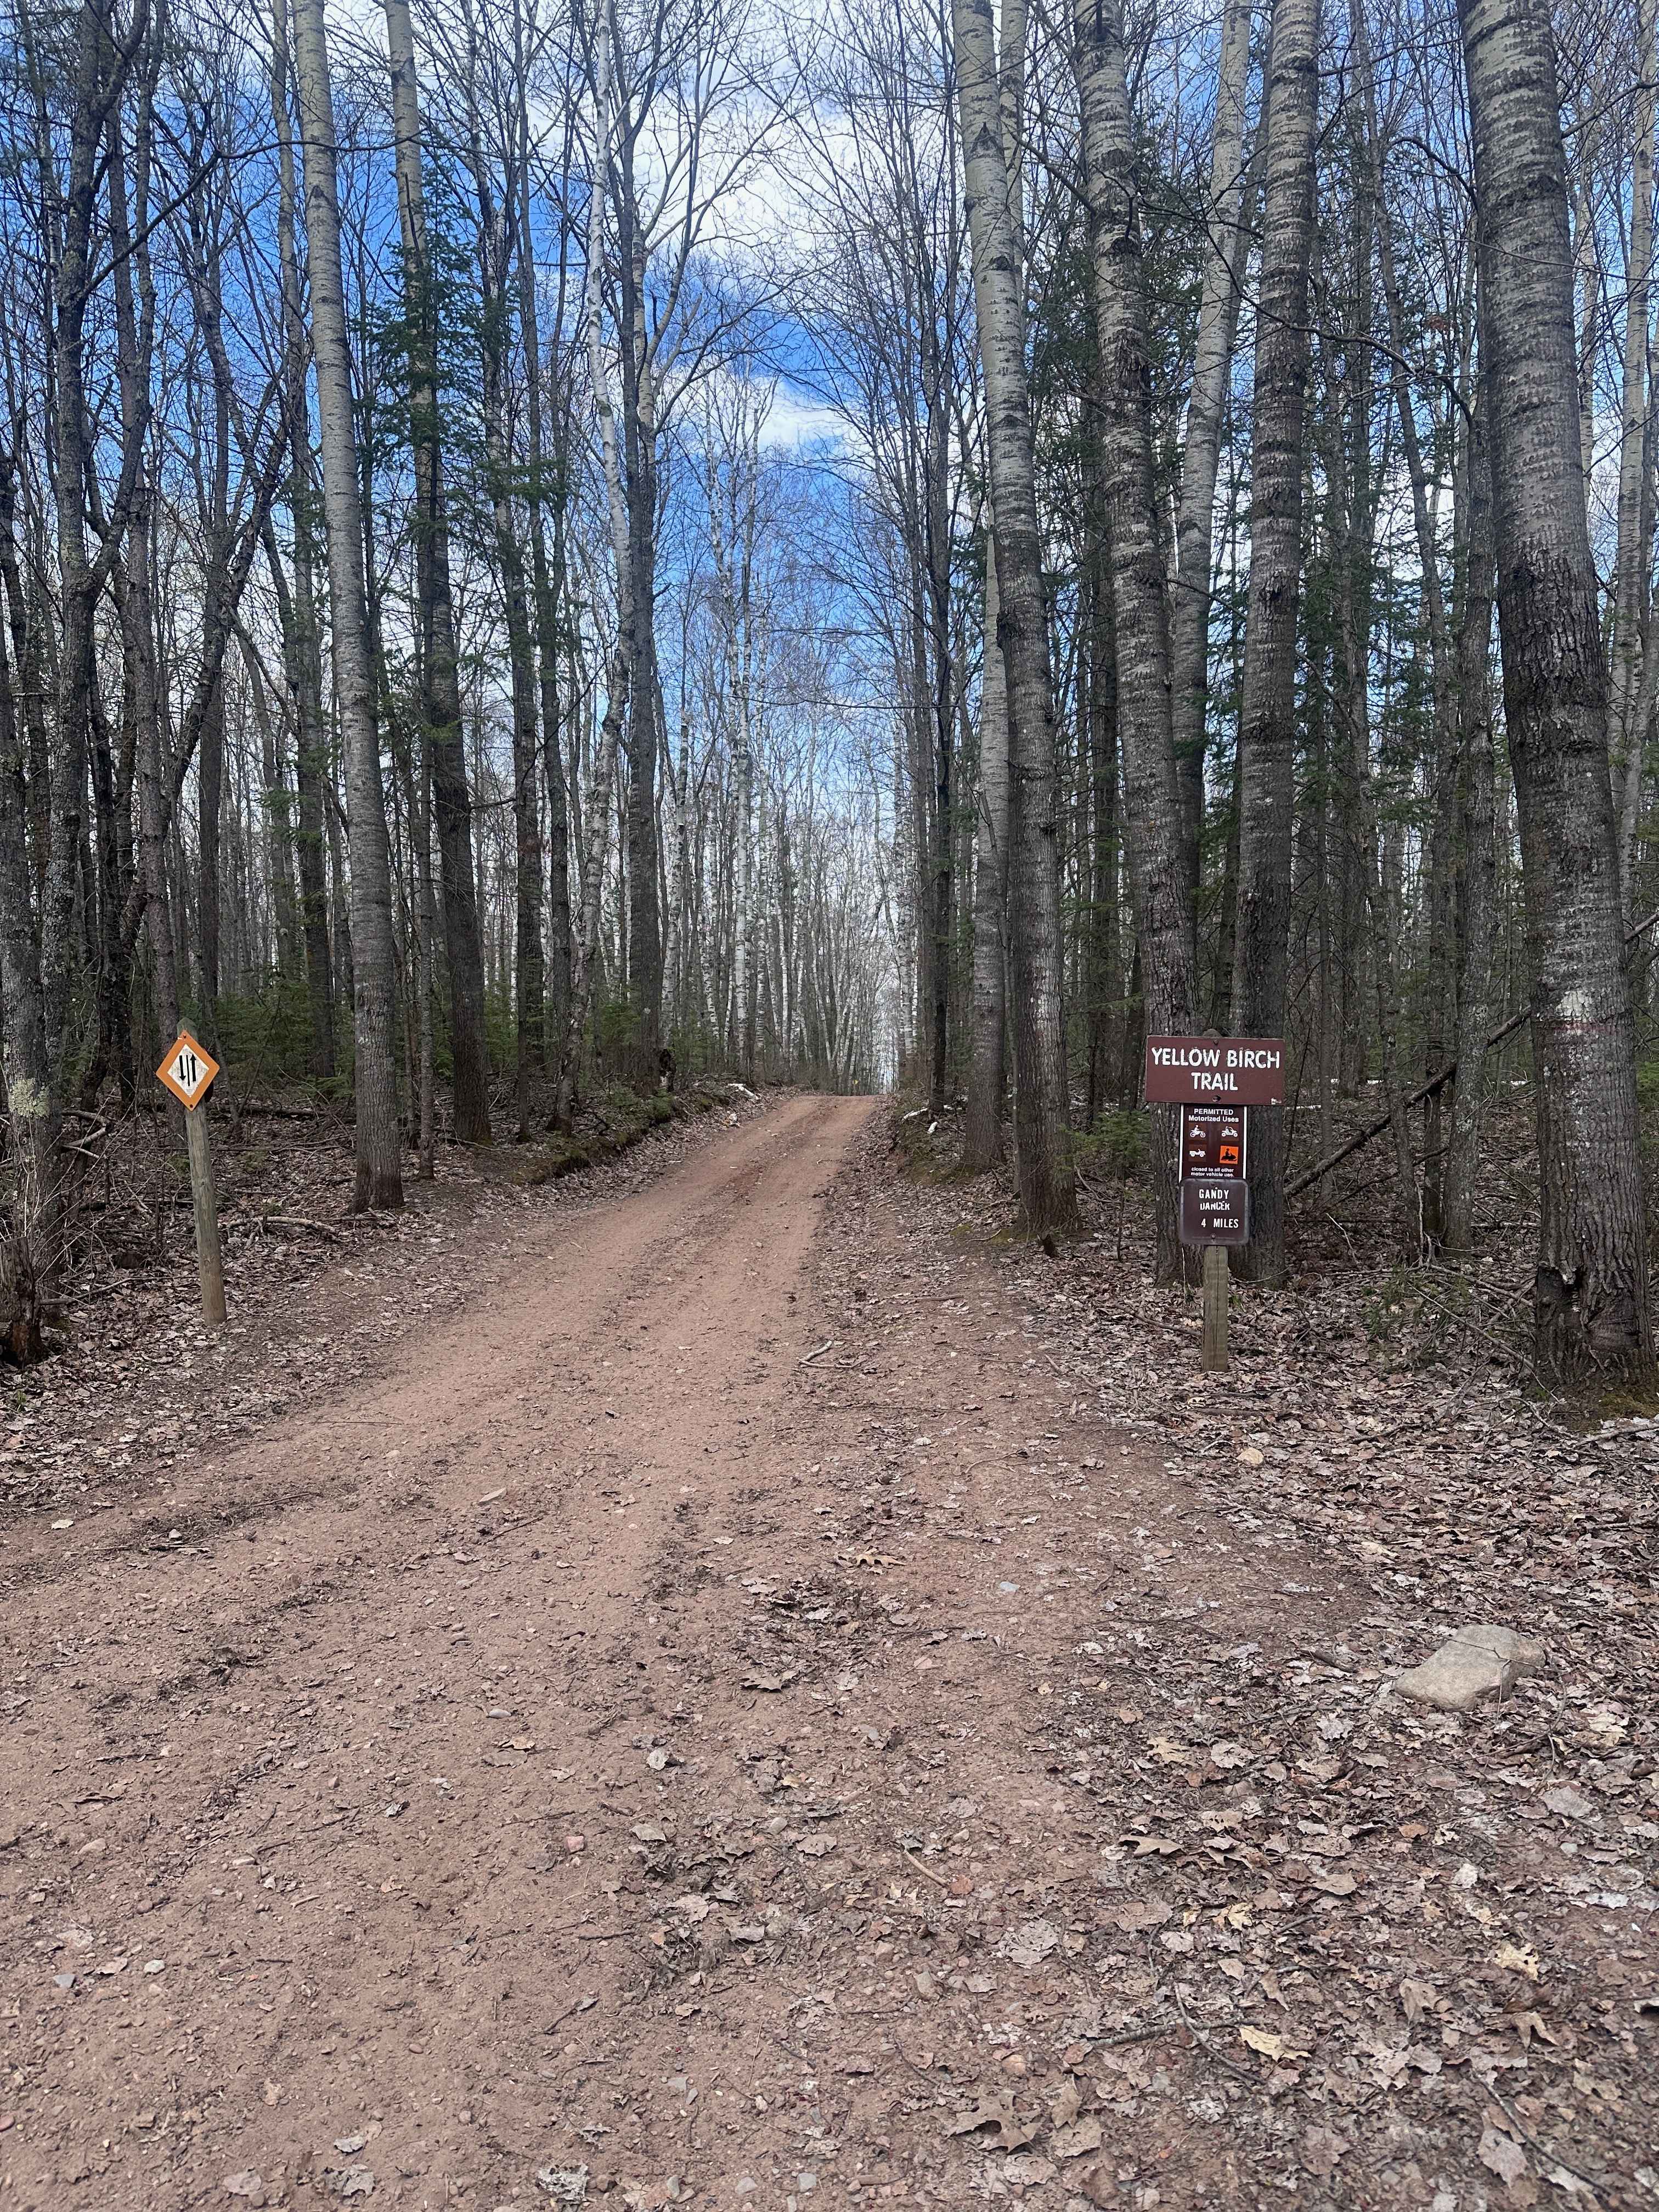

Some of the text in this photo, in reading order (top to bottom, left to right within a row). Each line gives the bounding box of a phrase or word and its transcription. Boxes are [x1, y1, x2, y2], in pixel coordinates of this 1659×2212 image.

[1152, 1047, 1280, 1069] YELLOW BIRCH
[1191, 1071, 1238, 1091] TRAIL
[1199, 1189, 1229, 1199] GANDY
[1201, 1218, 1239, 1228] 4 MILES
